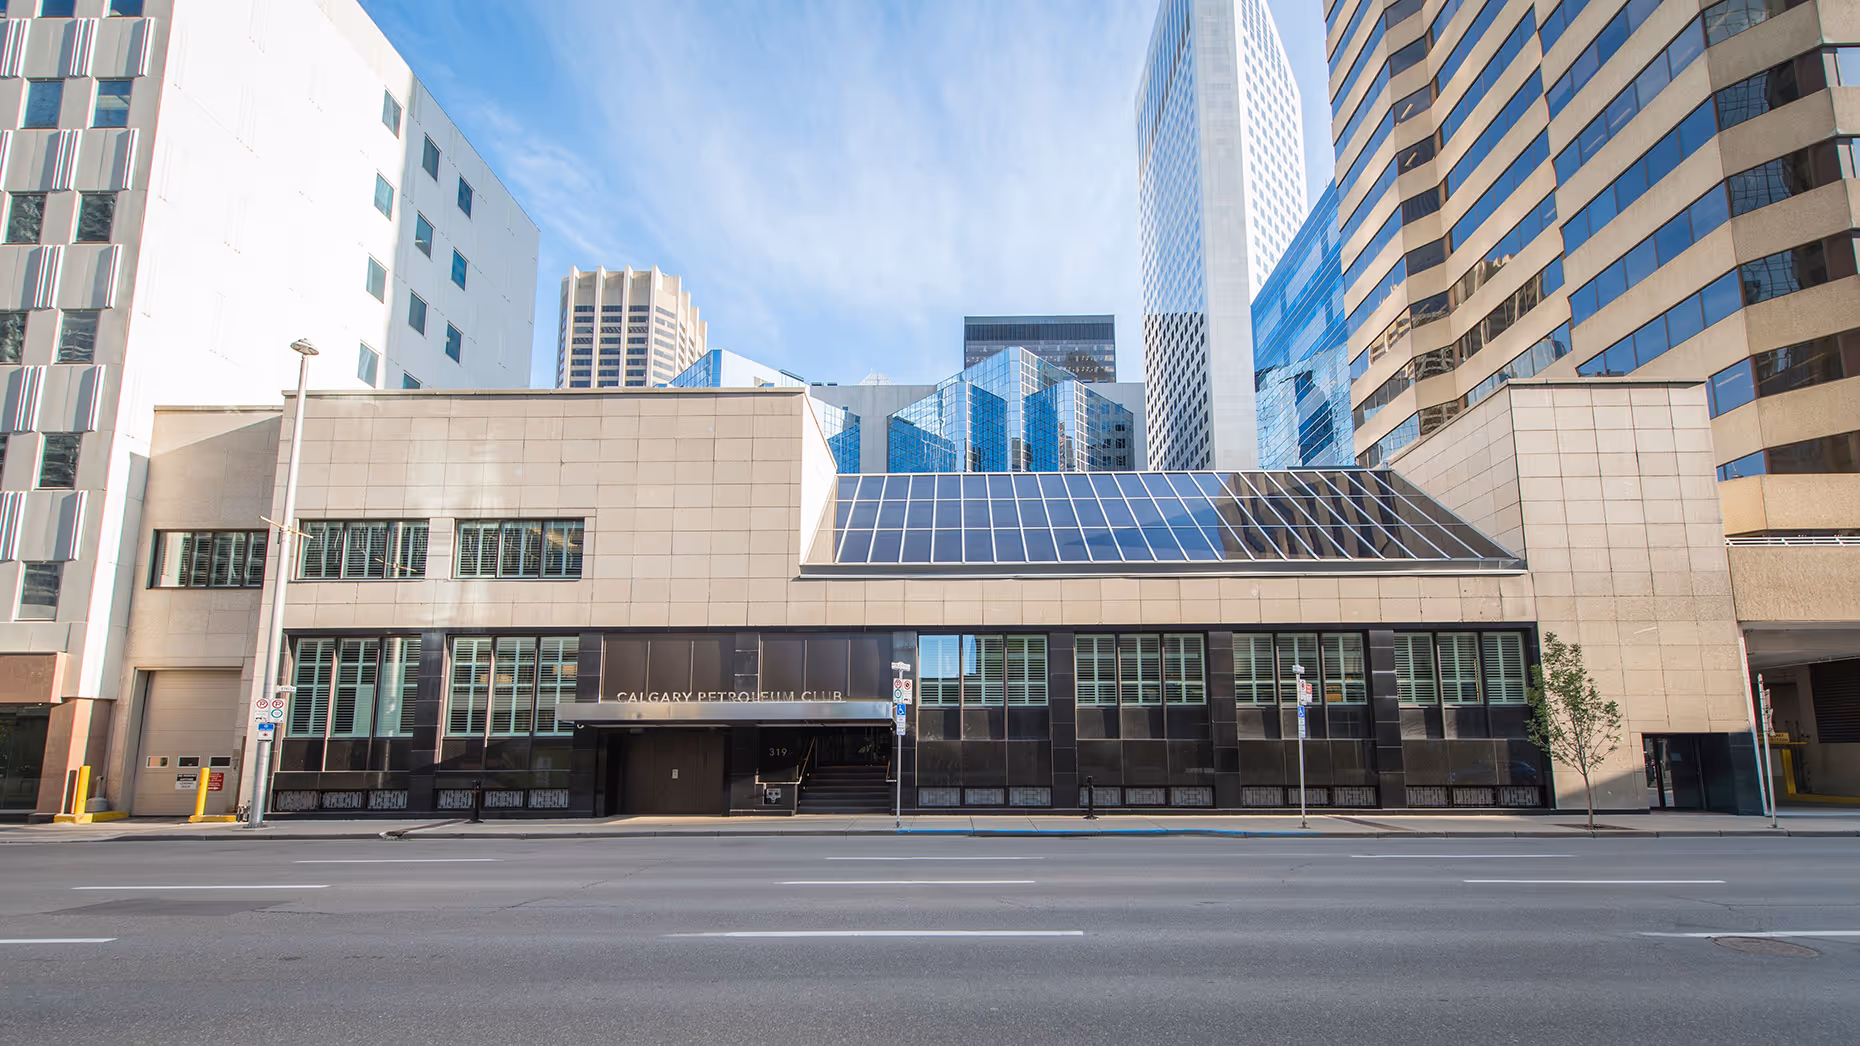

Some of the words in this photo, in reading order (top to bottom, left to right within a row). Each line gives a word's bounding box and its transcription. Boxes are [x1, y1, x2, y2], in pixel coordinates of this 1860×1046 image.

[616, 691, 693, 703] CALGARY
[698, 691, 795, 703] PETROLEUM
[801, 691, 842, 703] CLUB
[769, 748, 787, 757] 319
